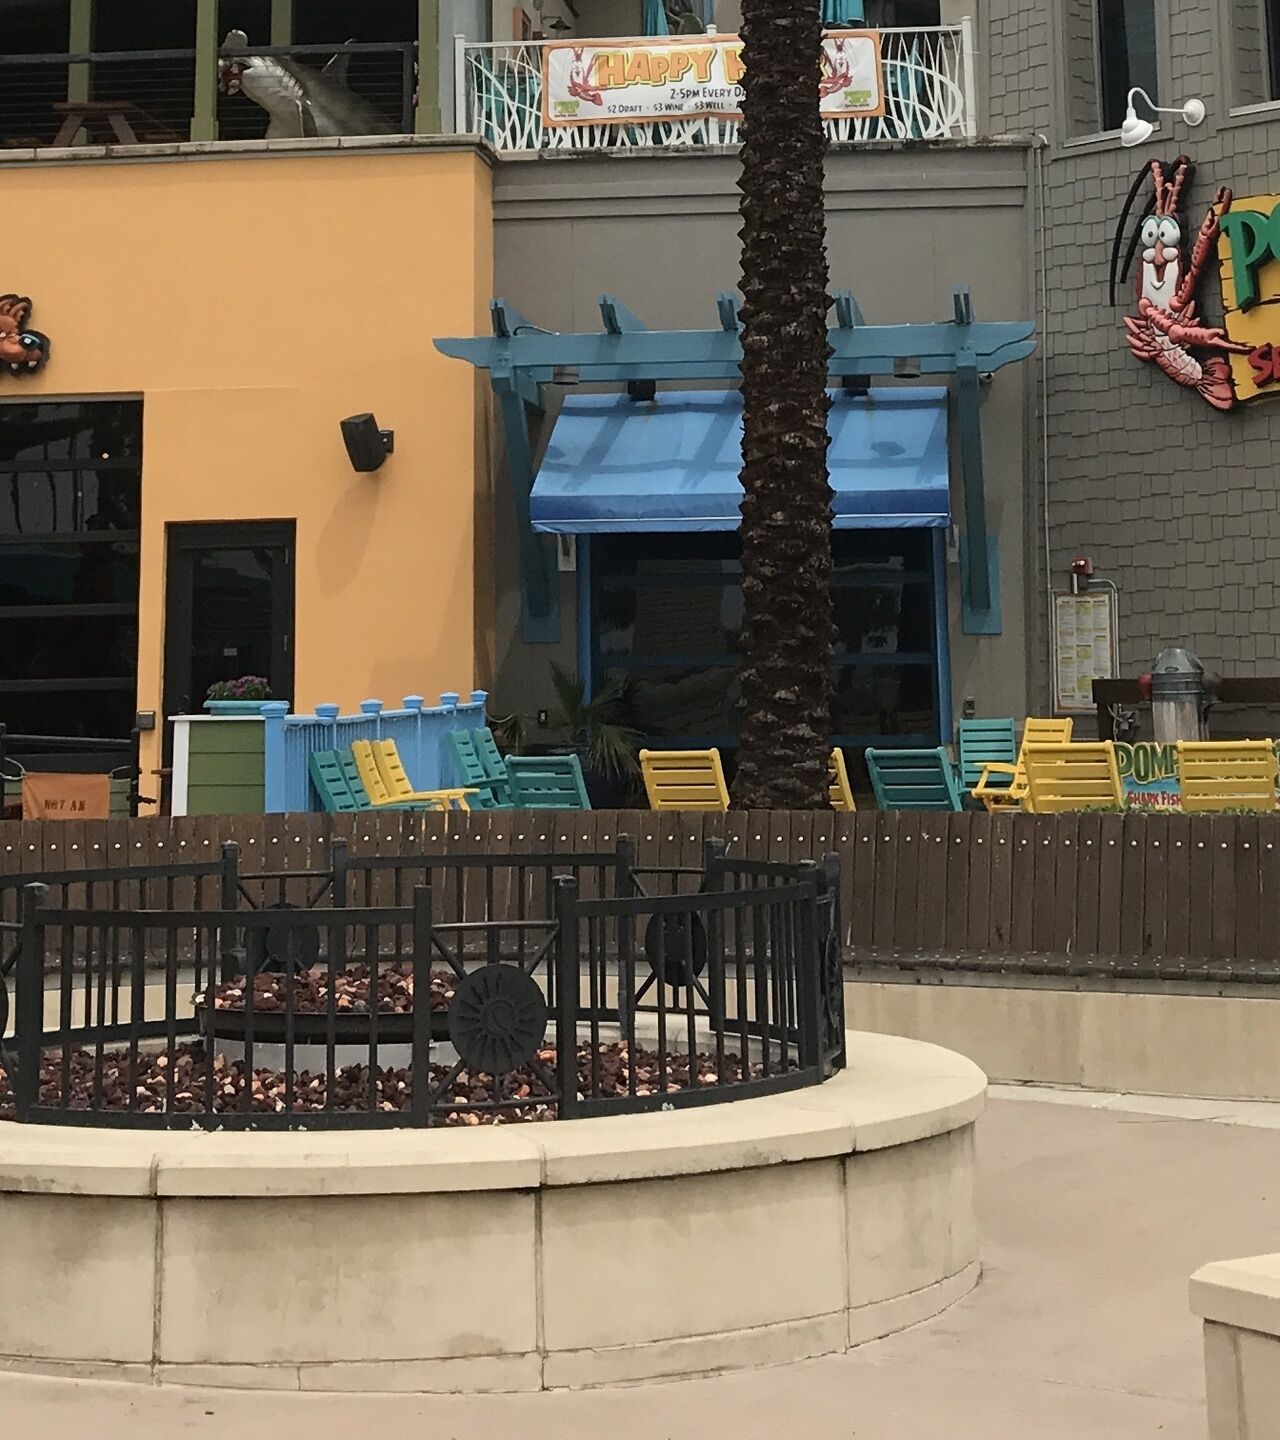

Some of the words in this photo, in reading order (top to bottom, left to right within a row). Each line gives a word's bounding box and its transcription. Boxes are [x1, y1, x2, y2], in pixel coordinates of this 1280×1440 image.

[596, 47, 716, 87] HAPPY
[702, 87, 731, 98] EVERY
[607, 104, 617, 114] $2
[618, 104, 642, 113] DRAFT
[653, 103, 663, 112] $3
[665, 103, 684, 111] WINE
[694, 101, 704, 110] $3
[705, 101, 725, 110] WELL
[44, 799, 66, 810] NOT
[1127, 790, 1160, 806] SHARK
